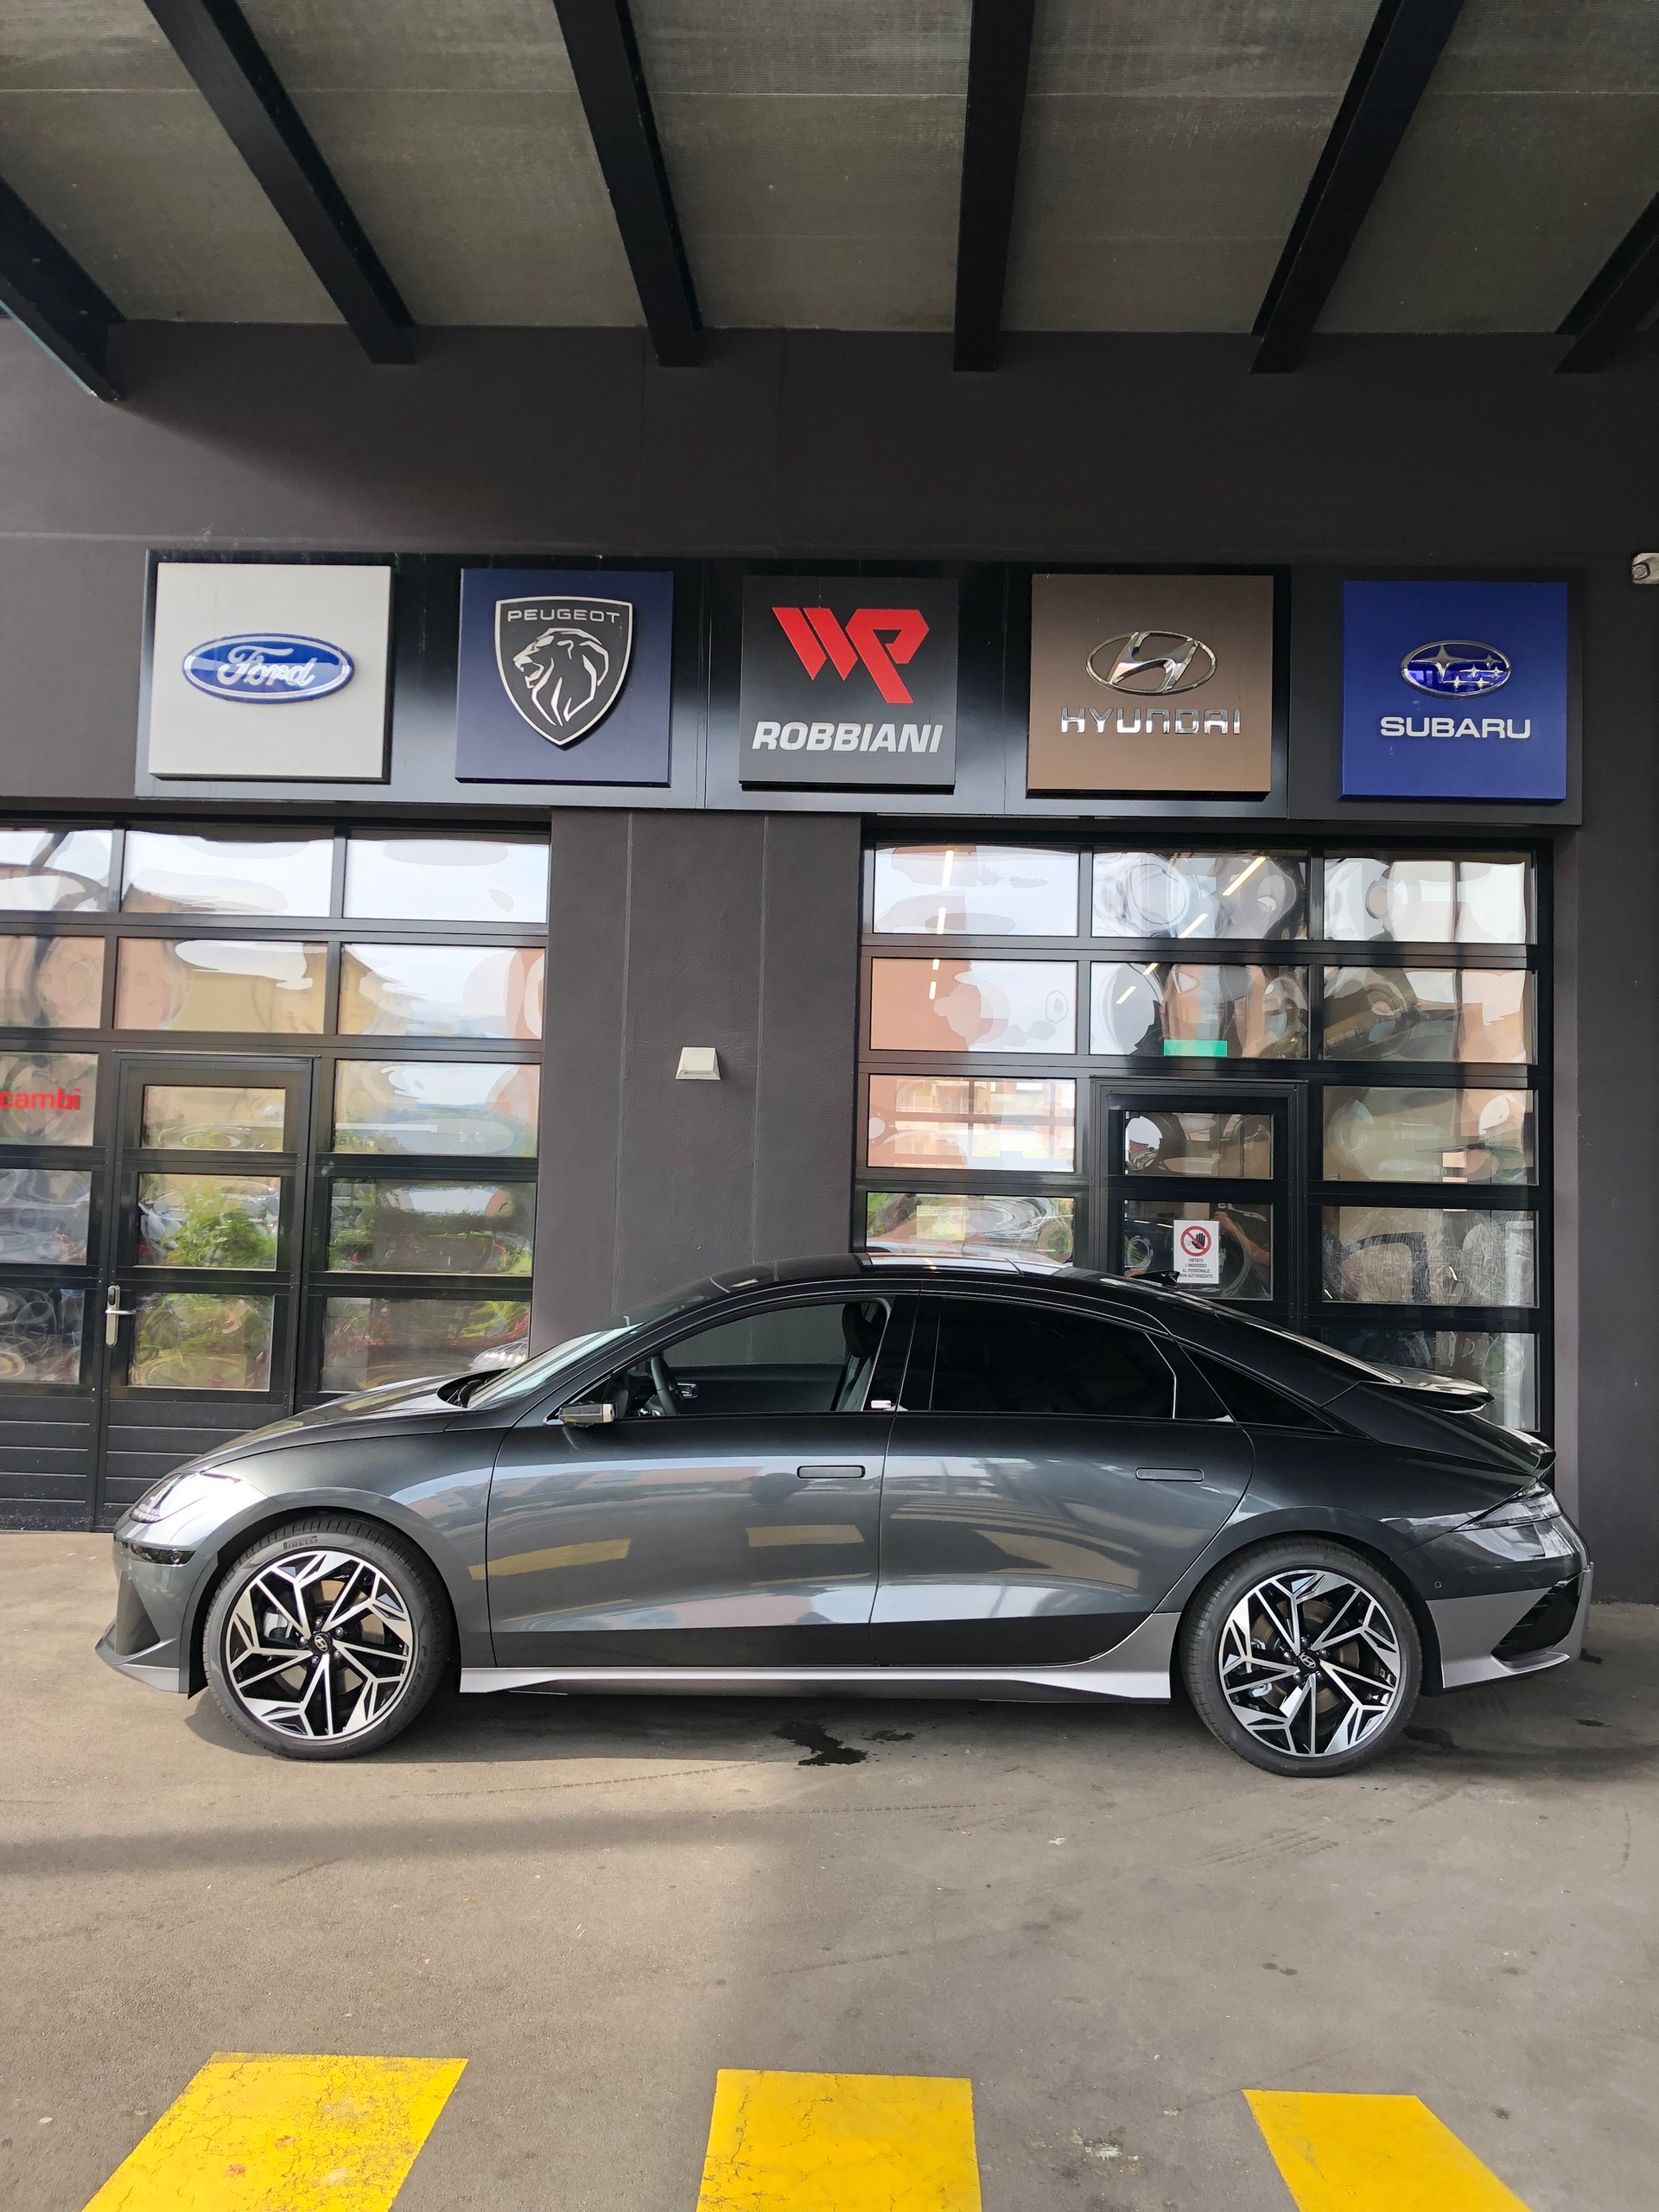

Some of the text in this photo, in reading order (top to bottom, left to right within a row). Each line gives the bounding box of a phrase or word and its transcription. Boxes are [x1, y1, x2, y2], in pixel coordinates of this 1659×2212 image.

[507, 608, 620, 624] PEUGEOT
[216, 645, 316, 688] Ford
[1060, 707, 1241, 735] HYUNDAI
[1380, 716, 1531, 739] SUBARU
[751, 721, 944, 754] ROBBIANI
[283, 1535, 318, 1549] PIRELLI
